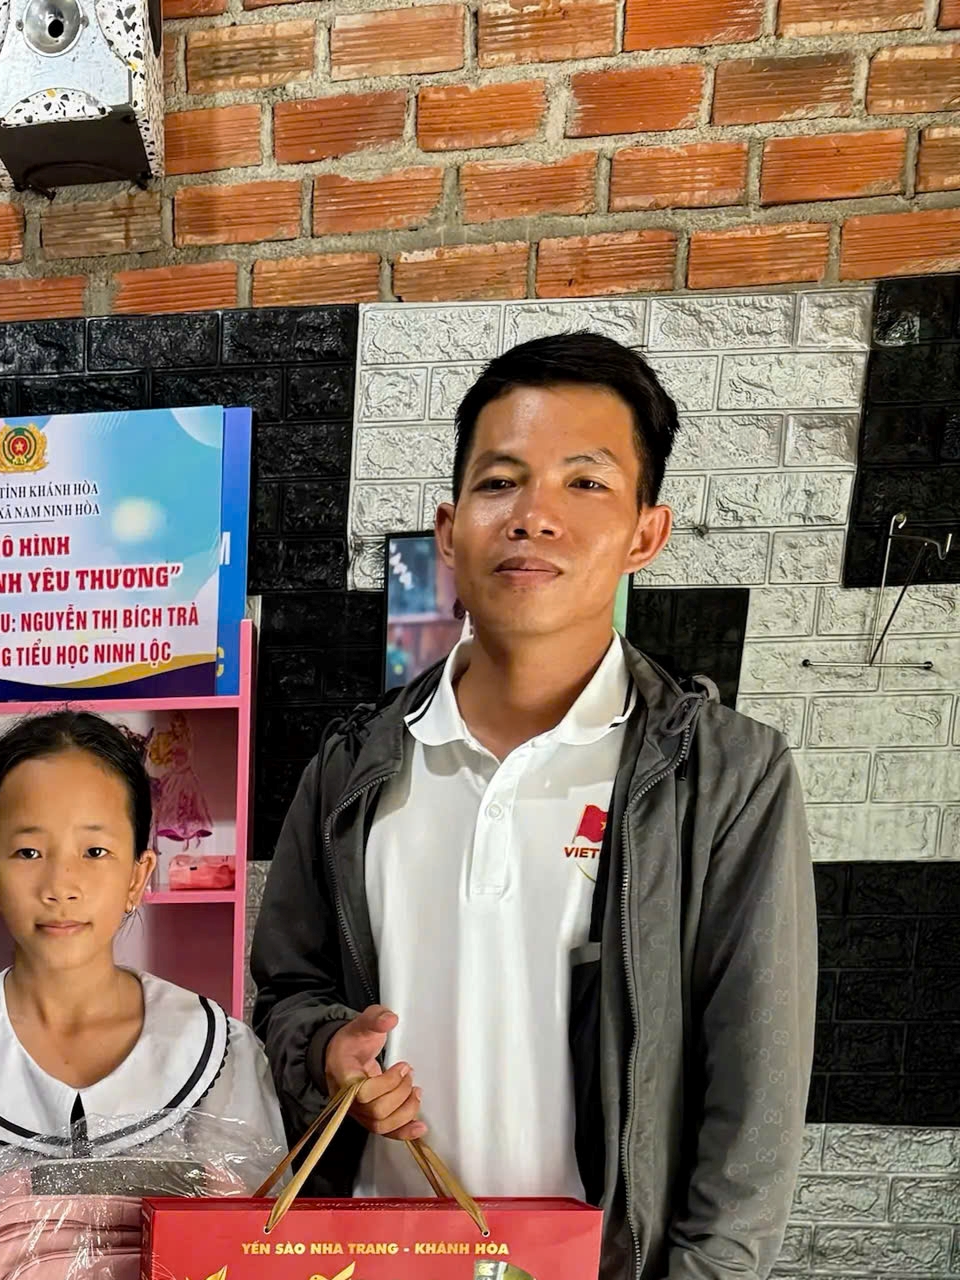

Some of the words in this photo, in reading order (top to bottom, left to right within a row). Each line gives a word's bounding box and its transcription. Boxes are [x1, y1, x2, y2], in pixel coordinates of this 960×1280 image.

[29, 482, 70, 498] KHÁNH
[74, 480, 98, 496] HÒA
[14, 505, 40, 519] NAM
[43, 504, 72, 517] NINH
[75, 500, 100, 516] HÒA
[19, 534, 70, 557] HÌNH
[28, 567, 70, 592] YÊU
[20, 604, 87, 632] NGUYỄN
[92, 609, 118, 633] THỊ
[122, 604, 162, 628] BÍCH
[167, 602, 199, 627] TRÀ
[16, 638, 51, 667] TIỂU
[57, 645, 89, 669] HỌC
[94, 643, 135, 664] NINH
[140, 638, 171, 667] LỘC
[564, 847, 600, 859] VIET
[242, 1240, 270, 1255] YẾN
[275, 1241, 305, 1255] SÀO
[310, 1243, 343, 1255] NHA
[348, 1243, 399, 1255] TRANG
[415, 1241, 469, 1255] KHÁNH
[475, 1241, 509, 1255] HÒA
